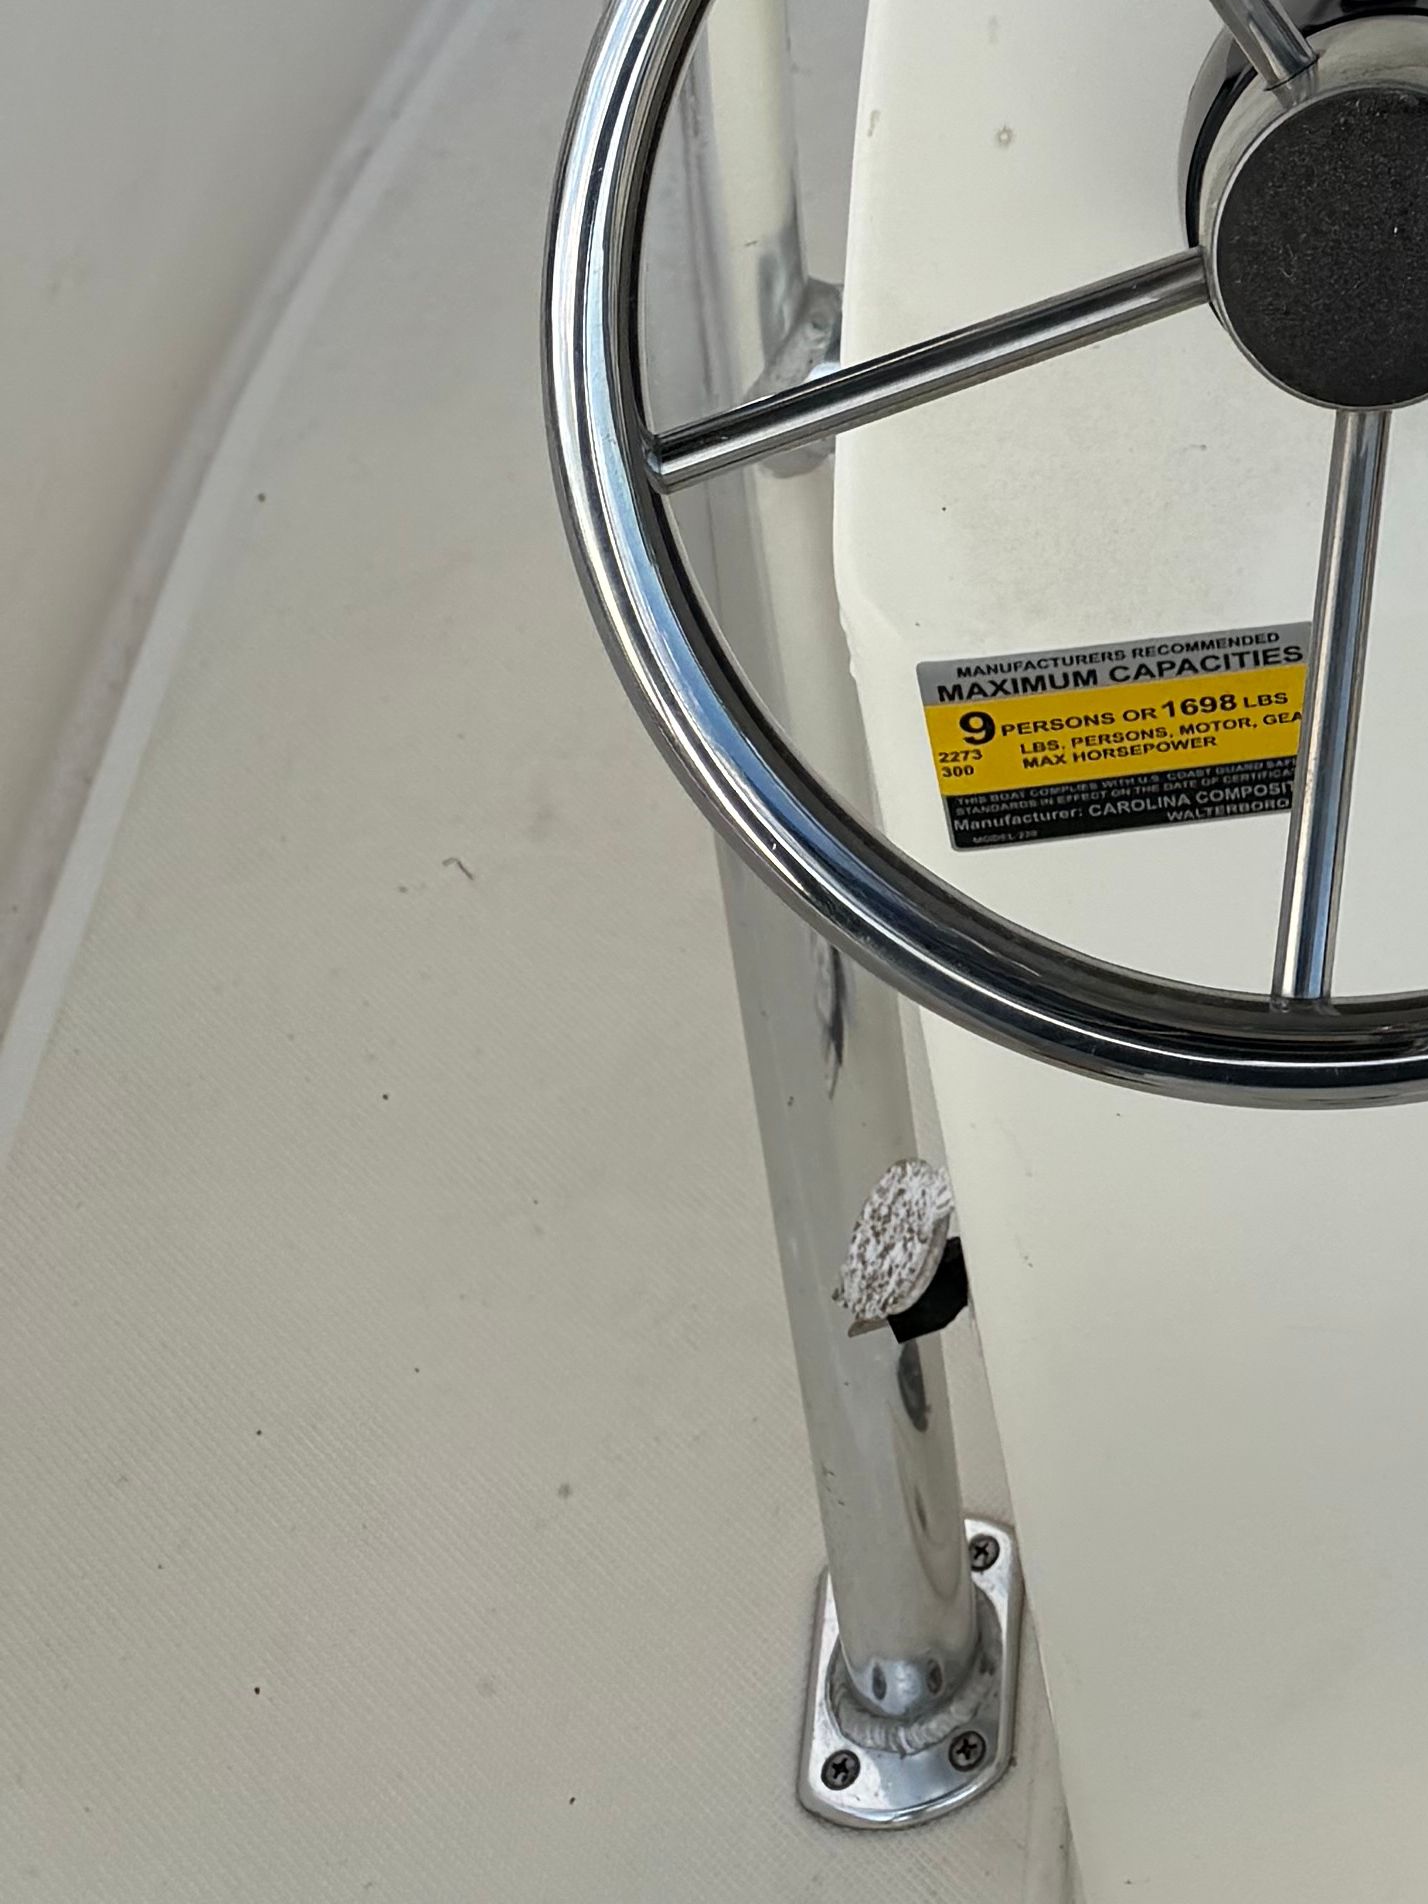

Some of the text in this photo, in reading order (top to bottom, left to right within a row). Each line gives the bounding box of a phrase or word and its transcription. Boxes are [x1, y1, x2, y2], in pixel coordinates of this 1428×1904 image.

[937, 645, 1304, 702] MAXIMUM CAPACITIES
[957, 632, 1280, 679] MANUFACTURERS RECOMMENDED
[959, 692, 1289, 746] 9 PERSONS OR 1698 LBS
[938, 749, 983, 764] 2273
[942, 736, 1217, 778] 300 MAX HORSEPOWER
[990, 791, 1025, 802] BOAT
[1134, 784, 1160, 795] THE
[1163, 780, 1197, 791] DATE
[954, 808, 1083, 832] Manufacturer:
[1088, 793, 1191, 817] CAROLINA
[1167, 798, 1290, 821] WALTERBORO
